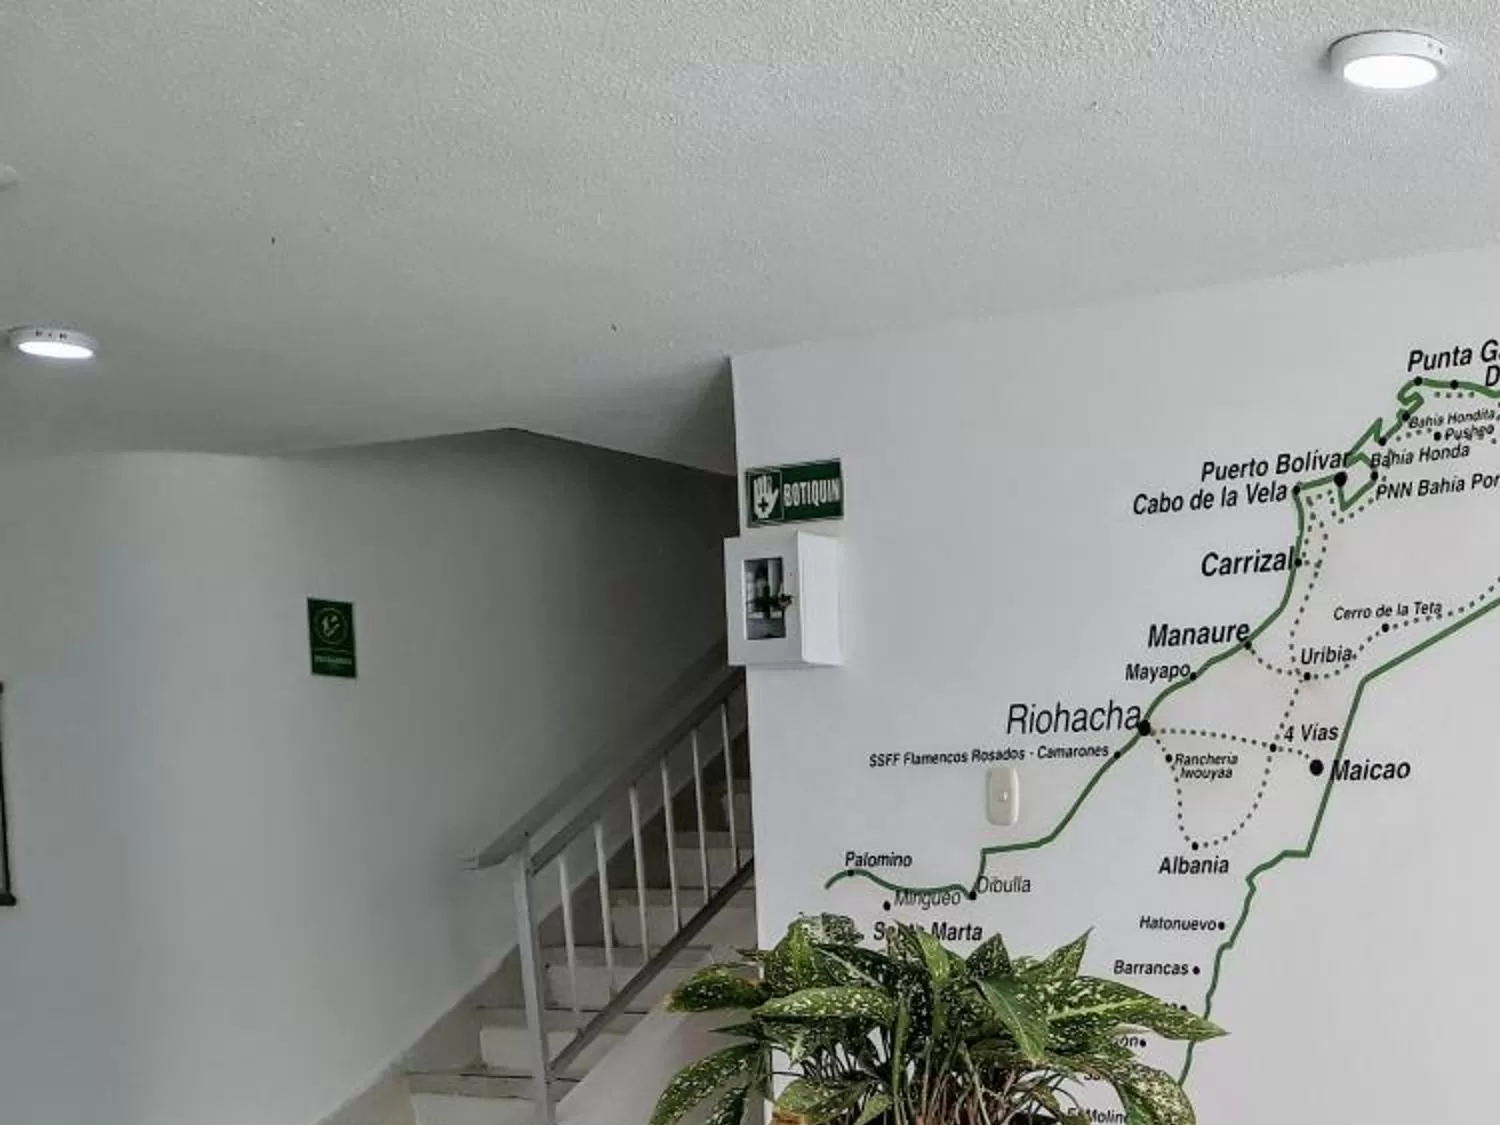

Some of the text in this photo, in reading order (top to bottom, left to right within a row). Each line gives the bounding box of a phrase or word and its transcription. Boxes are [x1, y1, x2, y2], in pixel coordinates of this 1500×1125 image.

[1407, 347, 1473, 372] Punta
[1419, 443, 1471, 463] Honda
[1201, 458, 1269, 482] Puerto
[1132, 480, 1288, 515] Cabo de la Vela
[1376, 481, 1412, 500] PNN
[1201, 545, 1295, 577] Carrizal
[1333, 601, 1442, 621] Cerro de la Teta
[1148, 622, 1250, 648] Manaure
[1300, 645, 1352, 665] Uribia
[1125, 663, 1191, 683] Mayapo
[1006, 700, 1142, 734] Riohacha
[1283, 726, 1294, 743] 4
[869, 753, 900, 768] SSFF
[903, 750, 968, 766] Flamencos
[971, 747, 1025, 763] Rosados
[1037, 745, 1109, 760] Camarones
[1330, 759, 1411, 781] Maicao
[845, 851, 913, 868] Palomino
[1158, 856, 1229, 875] Albania
[976, 876, 1031, 894] Dibulla
[894, 889, 961, 910] Mingueo
[931, 921, 983, 941] Marta
[1139, 915, 1217, 931] Hatonuevo
[1113, 959, 1189, 976] Barrancas
